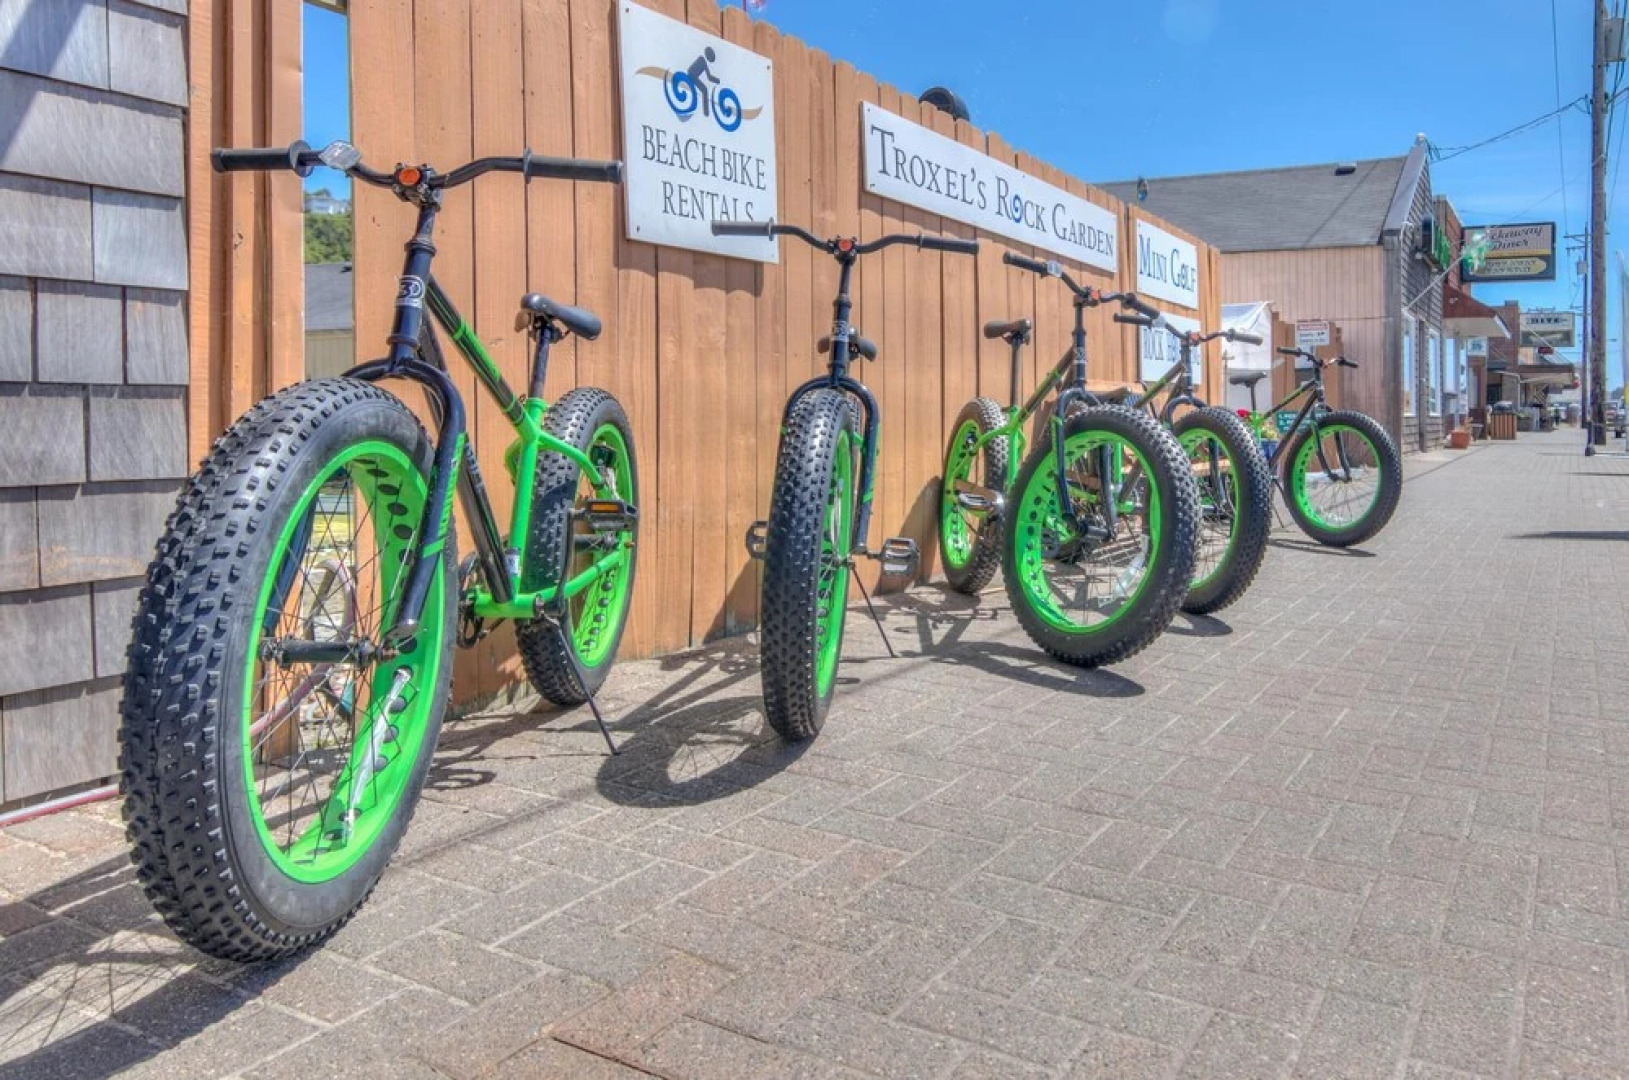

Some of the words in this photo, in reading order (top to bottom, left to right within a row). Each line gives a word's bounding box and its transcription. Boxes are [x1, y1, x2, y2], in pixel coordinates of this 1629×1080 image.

[642, 125, 717, 177] BEACH
[721, 148, 766, 190] BIKE
[996, 176, 1047, 233] ROCK
[1052, 203, 1114, 256] GARDEN
[1139, 234, 1167, 284] MINI
[1171, 248, 1195, 292] GOLF
